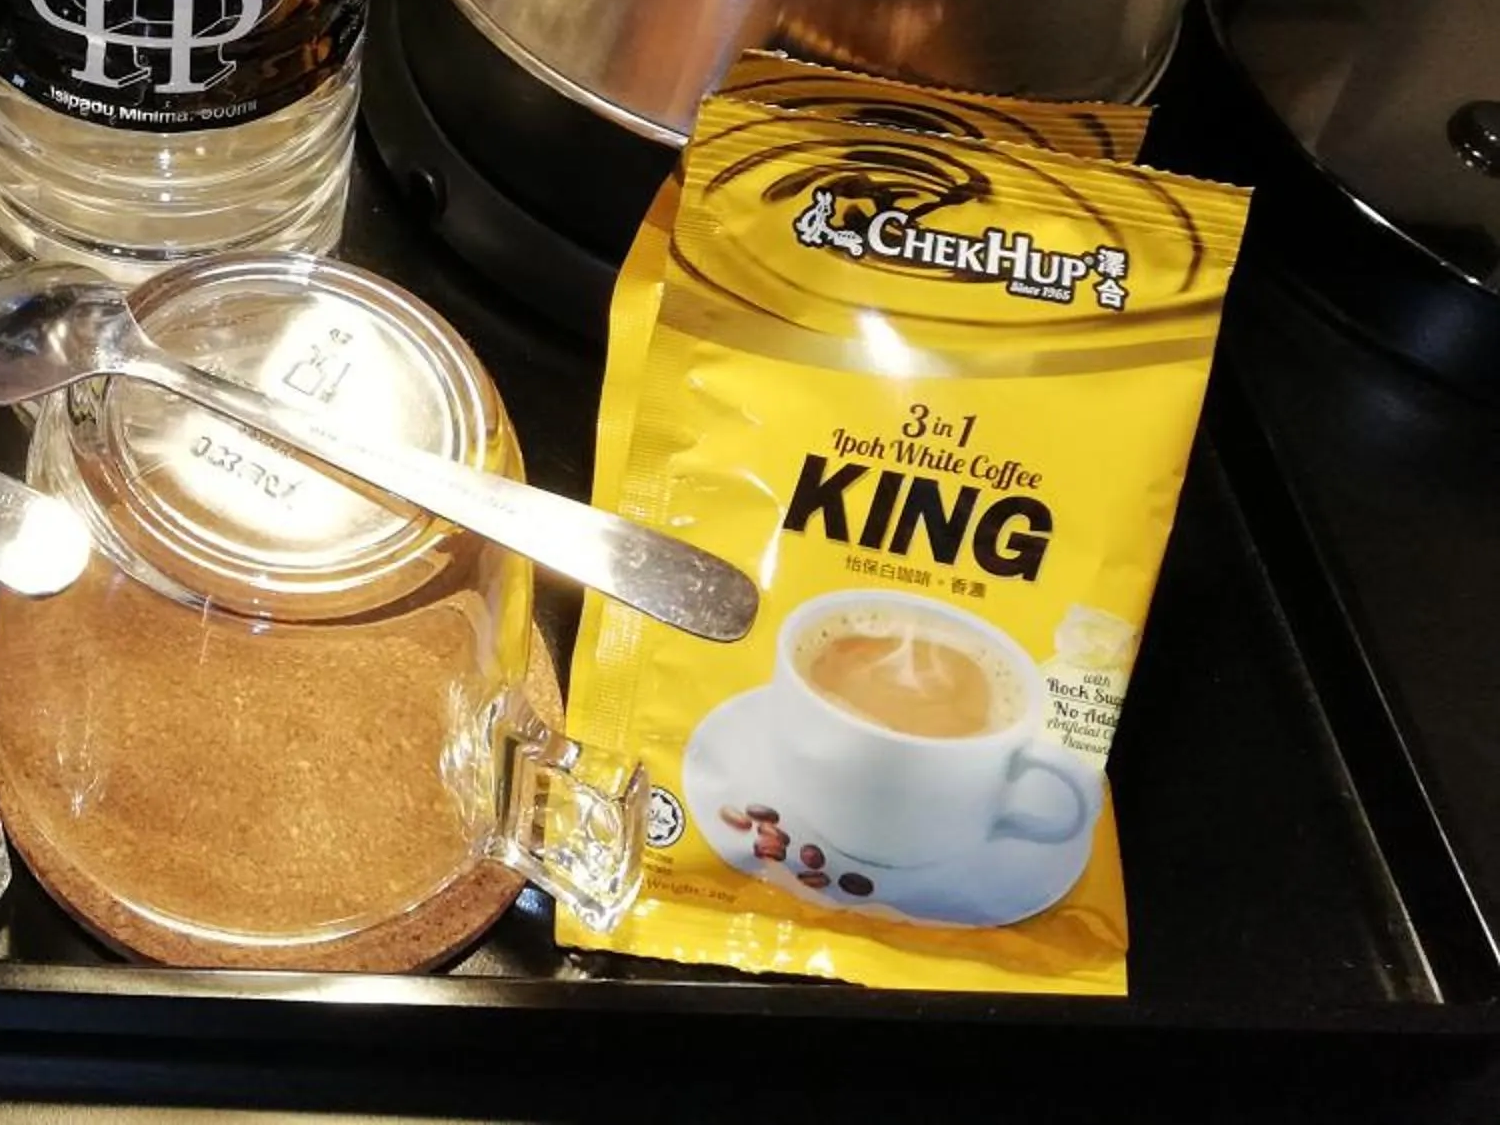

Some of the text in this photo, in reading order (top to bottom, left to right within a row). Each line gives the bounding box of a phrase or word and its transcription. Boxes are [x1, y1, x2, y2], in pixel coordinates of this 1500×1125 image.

[902, 403, 978, 449] 3 in 1
[832, 427, 1044, 491] Ipoh White Coffee
[783, 453, 1055, 583] KING
[1046, 676, 1125, 710] Rock Sug
[1053, 700, 1080, 720] No
